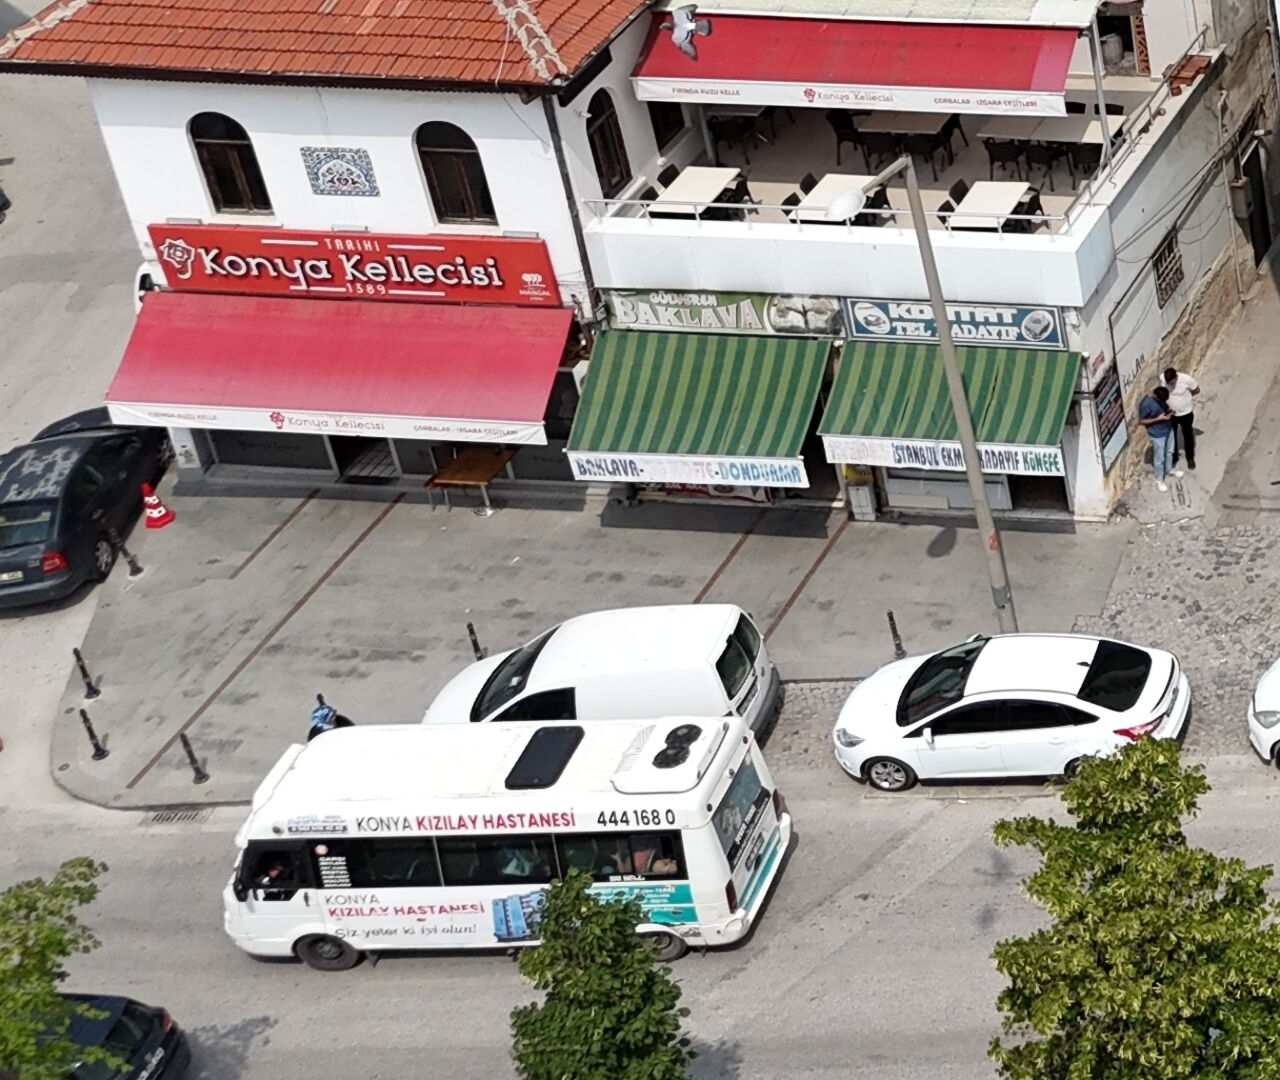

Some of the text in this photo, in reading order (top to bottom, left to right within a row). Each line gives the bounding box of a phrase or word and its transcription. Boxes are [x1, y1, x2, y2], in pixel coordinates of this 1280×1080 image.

[817, 92, 849, 103] Konya
[198, 247, 503, 288] Konya Kellecisi
[345, 284, 387, 295] 1389
[611, 294, 763, 329] BAKLAVA
[892, 322, 1020, 341] TEL ADAYIF
[287, 416, 385, 431] Konya Kellecisi
[892, 443, 939, 466] İSTANBUL
[356, 816, 413, 832] KONYA
[482, 807, 576, 830] HASTANESİ
[597, 810, 629, 827] 444
[633, 809, 661, 826] 168
[666, 809, 676, 825] 0
[325, 894, 380, 905] KONYA
[328, 901, 485, 917] KIZILAY HASTANESİ
[335, 924, 477, 939] Siz yeter ki iyi olun!
